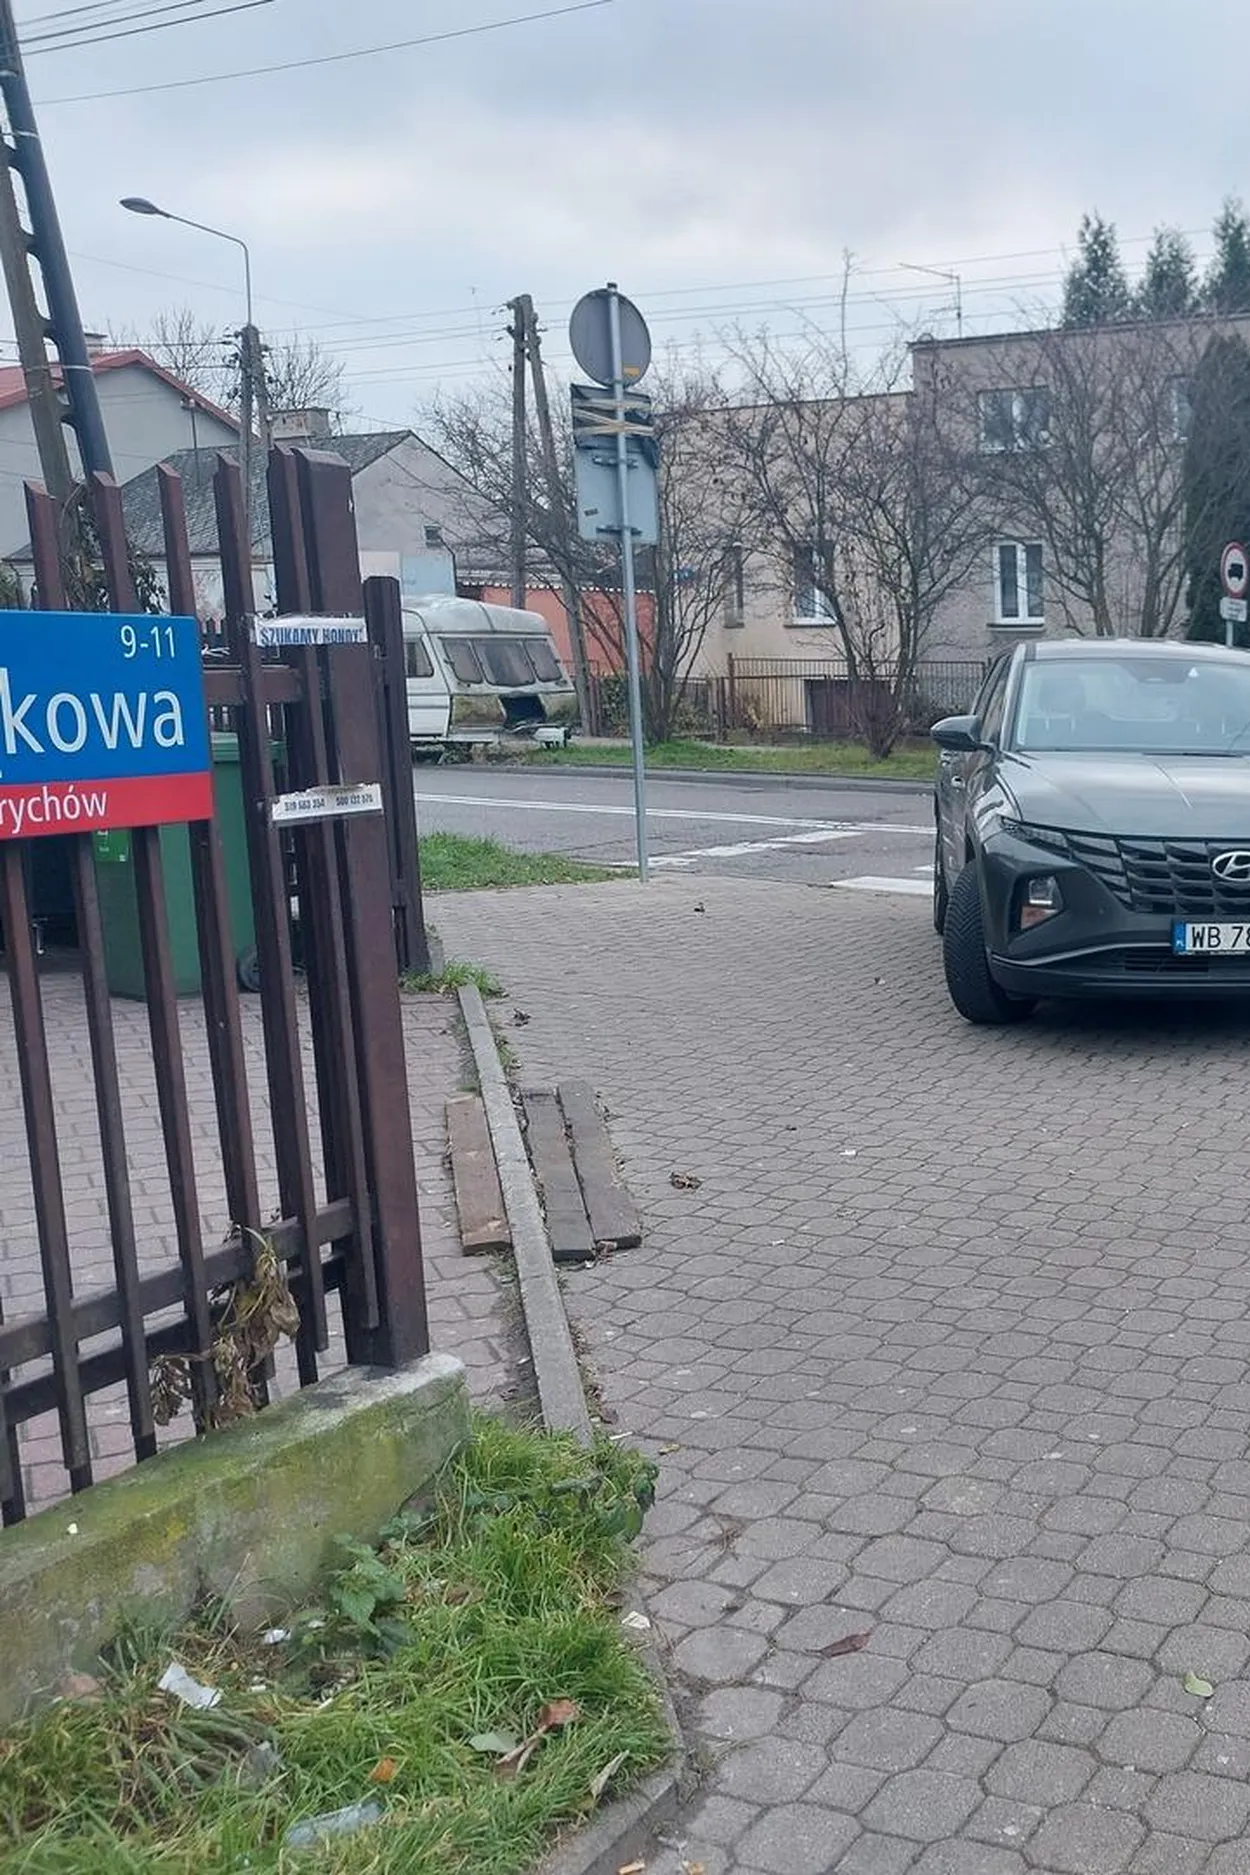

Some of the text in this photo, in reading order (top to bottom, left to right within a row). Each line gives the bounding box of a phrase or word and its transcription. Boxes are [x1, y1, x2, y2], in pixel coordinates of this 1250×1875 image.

[120, 625, 176, 660] 9-11
[0, 667, 184, 755] kowa
[1191, 926, 1221, 949] WB
